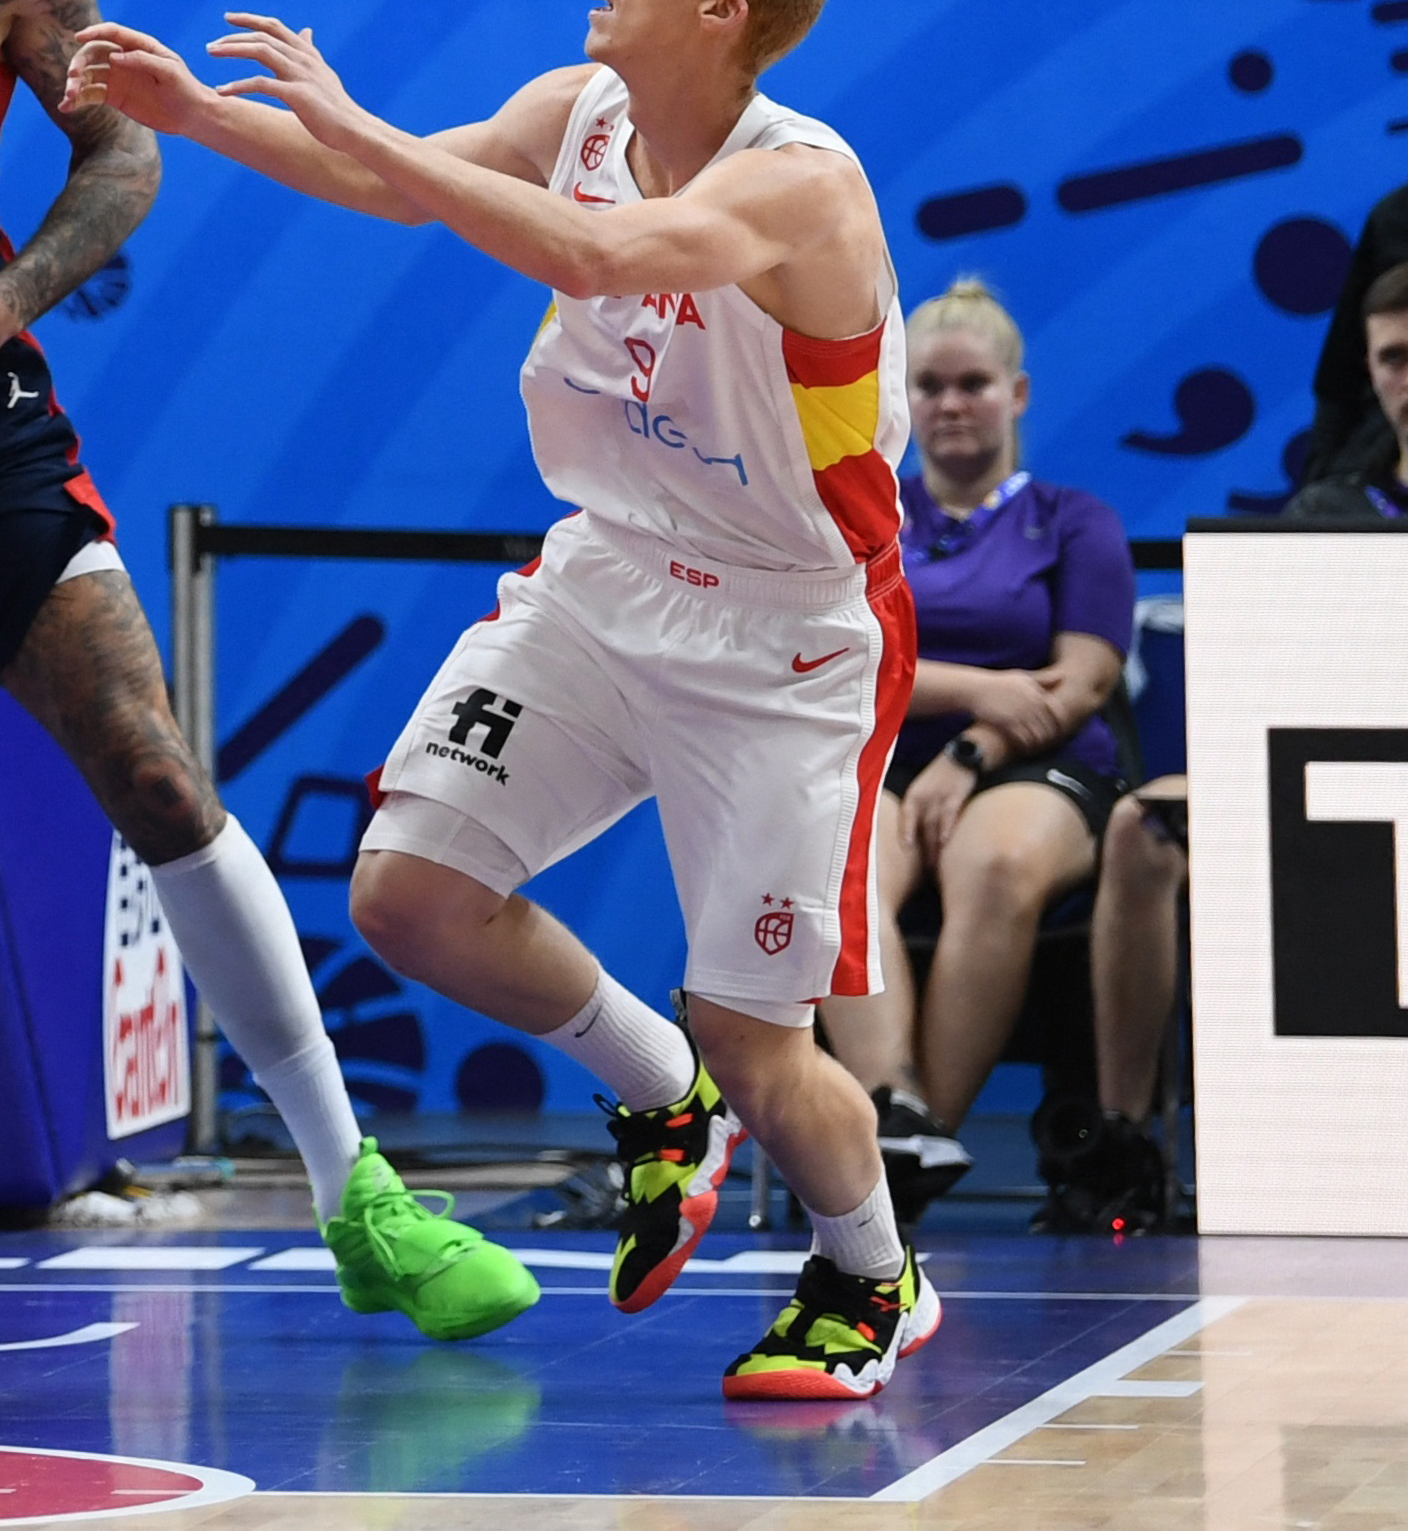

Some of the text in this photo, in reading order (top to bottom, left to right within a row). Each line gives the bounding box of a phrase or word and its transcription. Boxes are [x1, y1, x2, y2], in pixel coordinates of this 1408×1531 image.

[670, 560, 720, 589] ESP
[450, 687, 524, 760] fi
[425, 741, 511, 787] network
